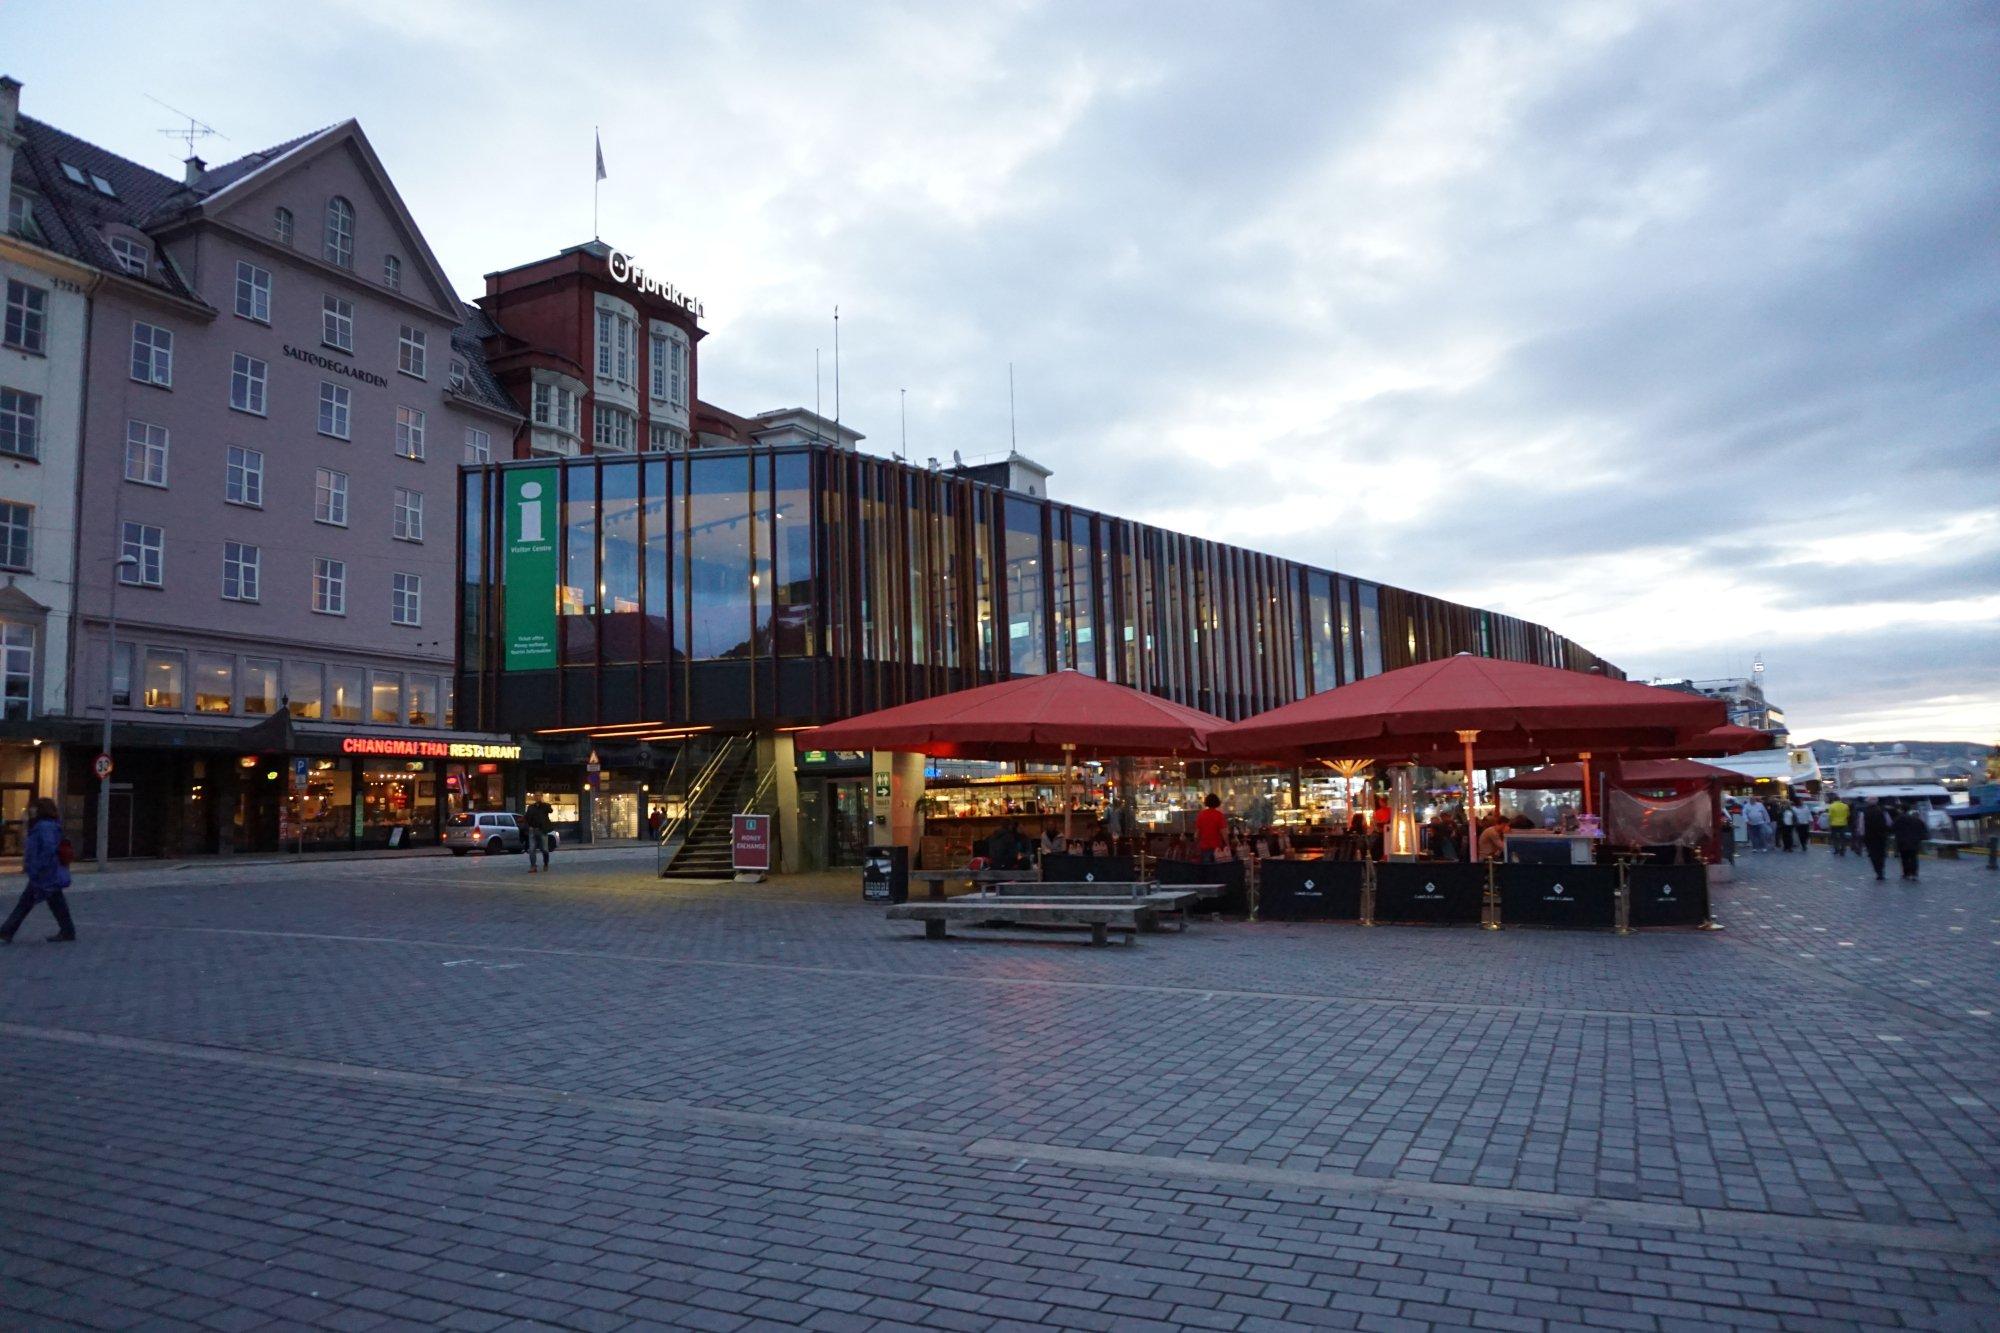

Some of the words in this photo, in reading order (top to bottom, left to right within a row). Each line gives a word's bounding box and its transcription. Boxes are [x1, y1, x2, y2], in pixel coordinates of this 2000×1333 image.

[343, 738, 418, 755] CHIANGMAI
[421, 741, 448, 756] THAI
[450, 743, 521, 759] RESTAURANT
